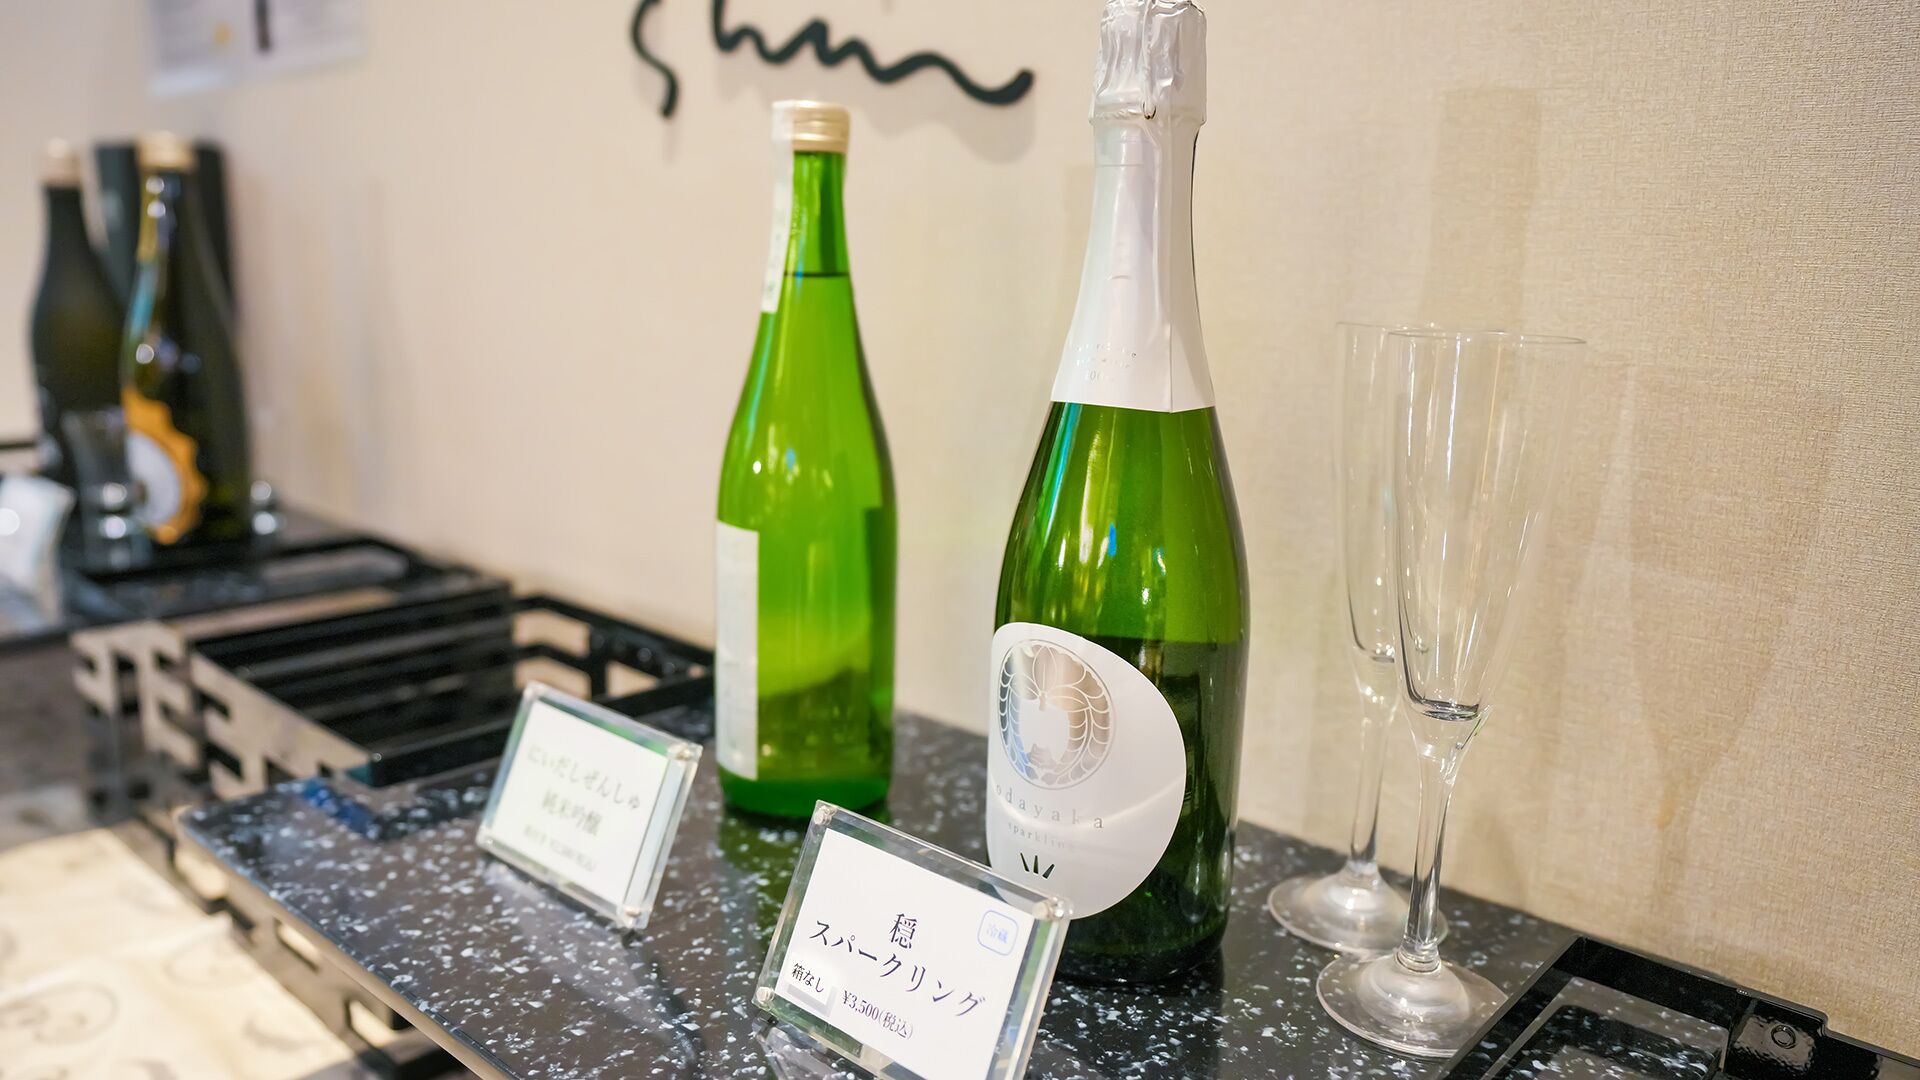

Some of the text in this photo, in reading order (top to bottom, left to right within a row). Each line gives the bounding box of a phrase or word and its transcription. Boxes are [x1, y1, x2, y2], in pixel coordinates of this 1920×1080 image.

[996, 783, 1105, 829] odayaka
[888, 912, 918, 950] 穏
[791, 962, 825, 994] 箱なし
[809, 919, 986, 1018] スパークリング
